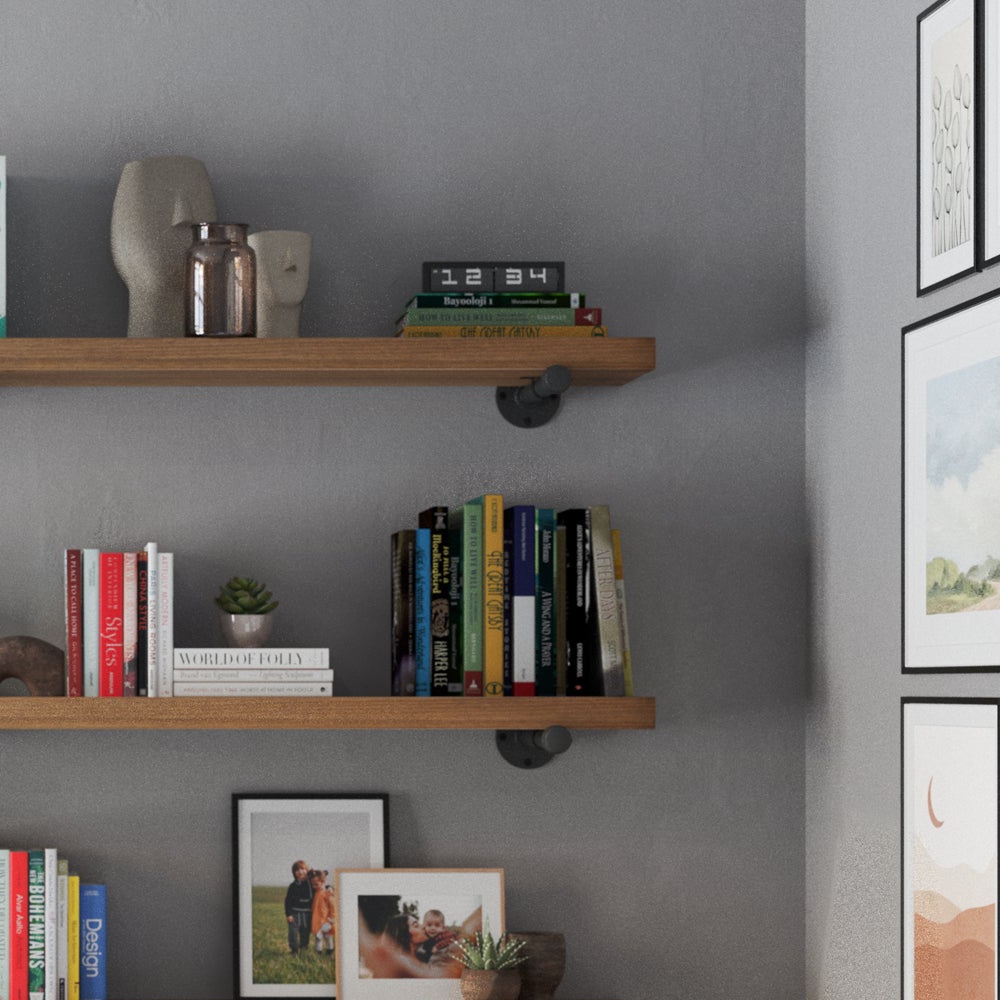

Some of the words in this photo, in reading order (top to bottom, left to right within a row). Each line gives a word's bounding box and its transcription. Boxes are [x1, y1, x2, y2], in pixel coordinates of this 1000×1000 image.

[443, 296, 486, 307] Bayooloji
[470, 540, 476, 548] TO
[488, 551, 503, 566] THE
[595, 548, 614, 586] AFTER
[71, 584, 77, 596] TO
[139, 570, 147, 602] CHINA
[449, 556, 460, 600] Bayooloji
[488, 570, 503, 596] GREAT
[139, 604, 147, 631] STYLE
[488, 599, 503, 631] GATSBY
[542, 597, 552, 618] WING
[600, 589, 617, 622] DAYS
[542, 620, 552, 635] AND
[100, 616, 122, 667] Styles
[179, 653, 234, 665] WORLD
[236, 653, 256, 665] OF
[259, 653, 303, 665] FOLLY
[434, 641, 448, 671] HARPER
[541, 642, 552, 668] PRAYER
[434, 673, 447, 688] LEE
[15, 894, 24, 912] Alvar
[15, 914, 24, 934] Aalto
[30, 885, 44, 968] BOHEMIANS
[82, 918, 102, 978] Design
